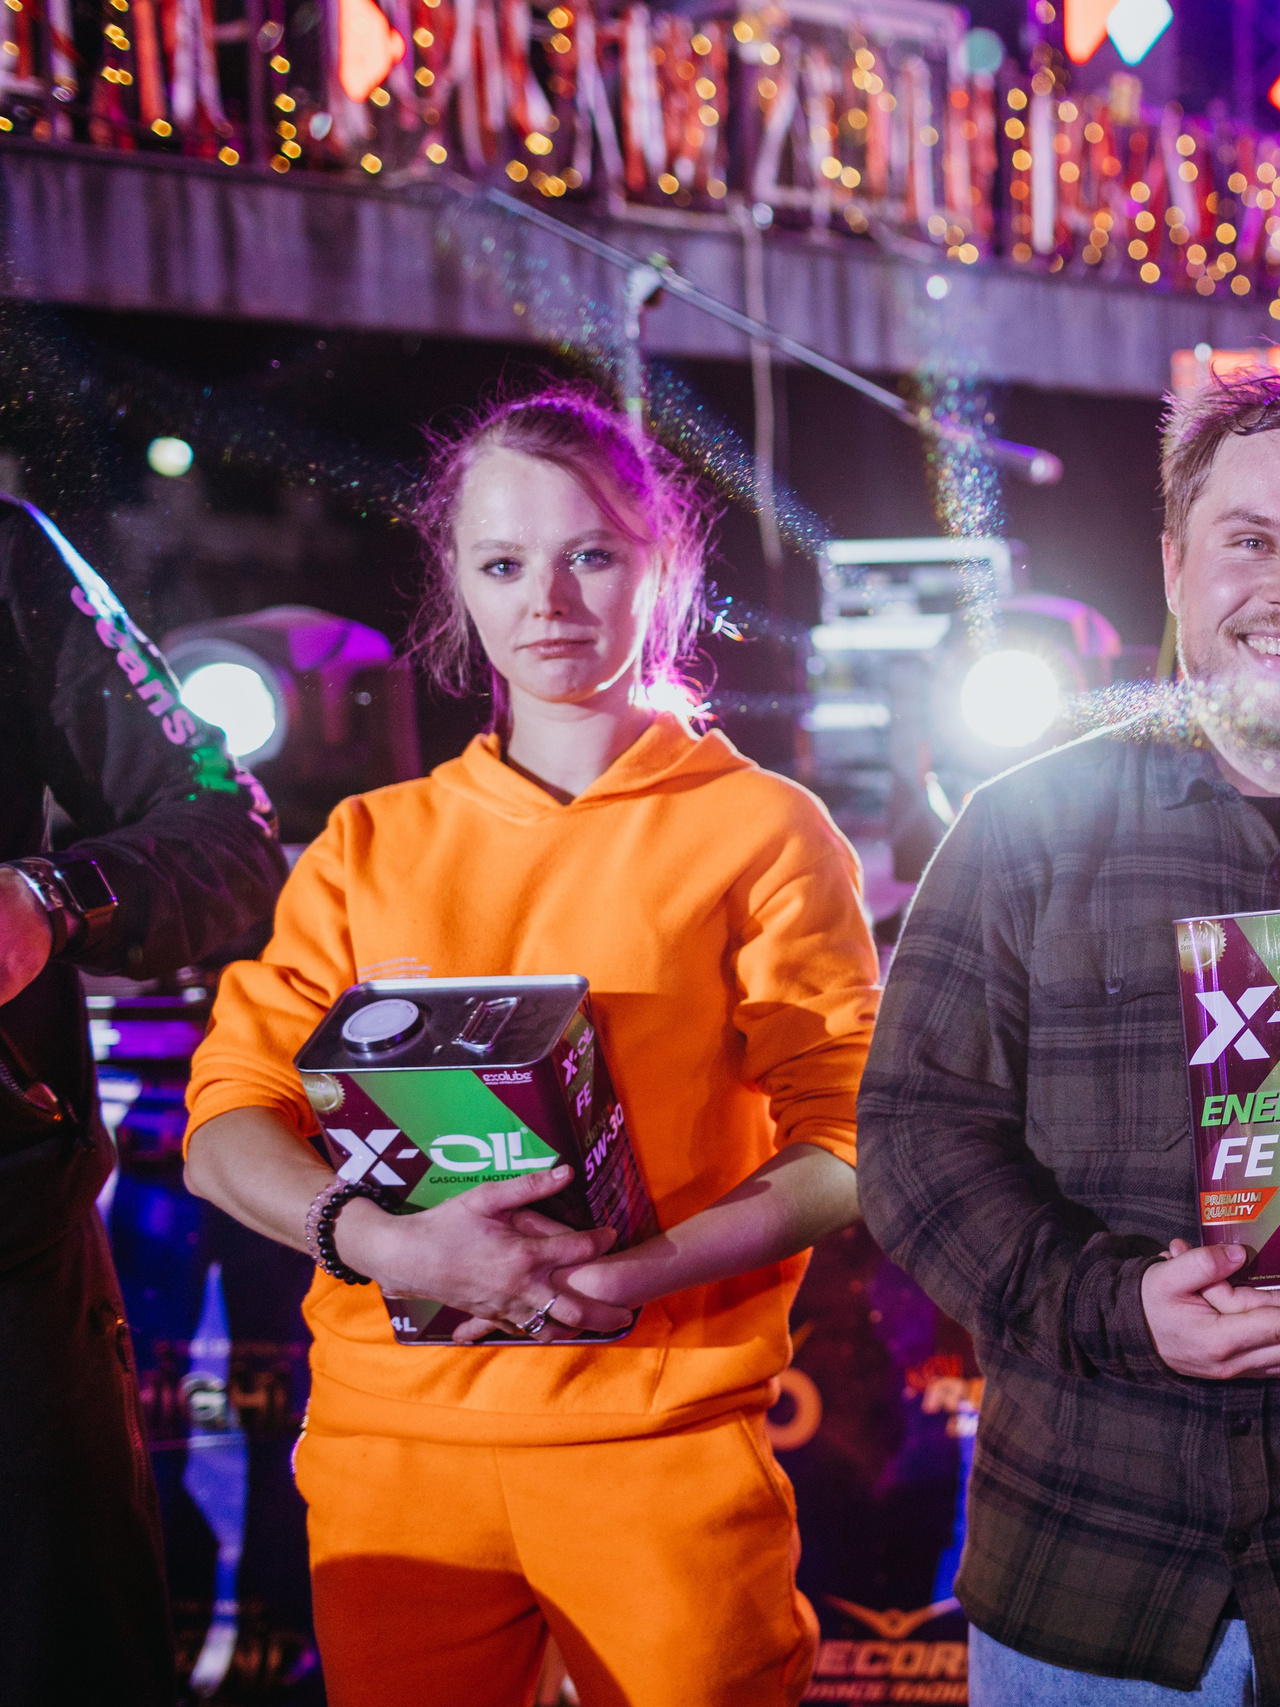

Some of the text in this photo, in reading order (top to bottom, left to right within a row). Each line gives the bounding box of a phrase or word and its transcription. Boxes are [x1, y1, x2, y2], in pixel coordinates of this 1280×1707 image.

[482, 1070, 532, 1082] exolube
[576, 1081, 592, 1117] FE
[326, 1128, 557, 1186] X-OIL
[585, 1103, 624, 1181] 5W-30
[1211, 1134, 1279, 1181] FE
[429, 1174, 480, 1184] GASOLINE
[1203, 1204, 1255, 1220] QUALITY
[1204, 1191, 1262, 1206] PREMIUM
[819, 1640, 968, 1677] ECOR
